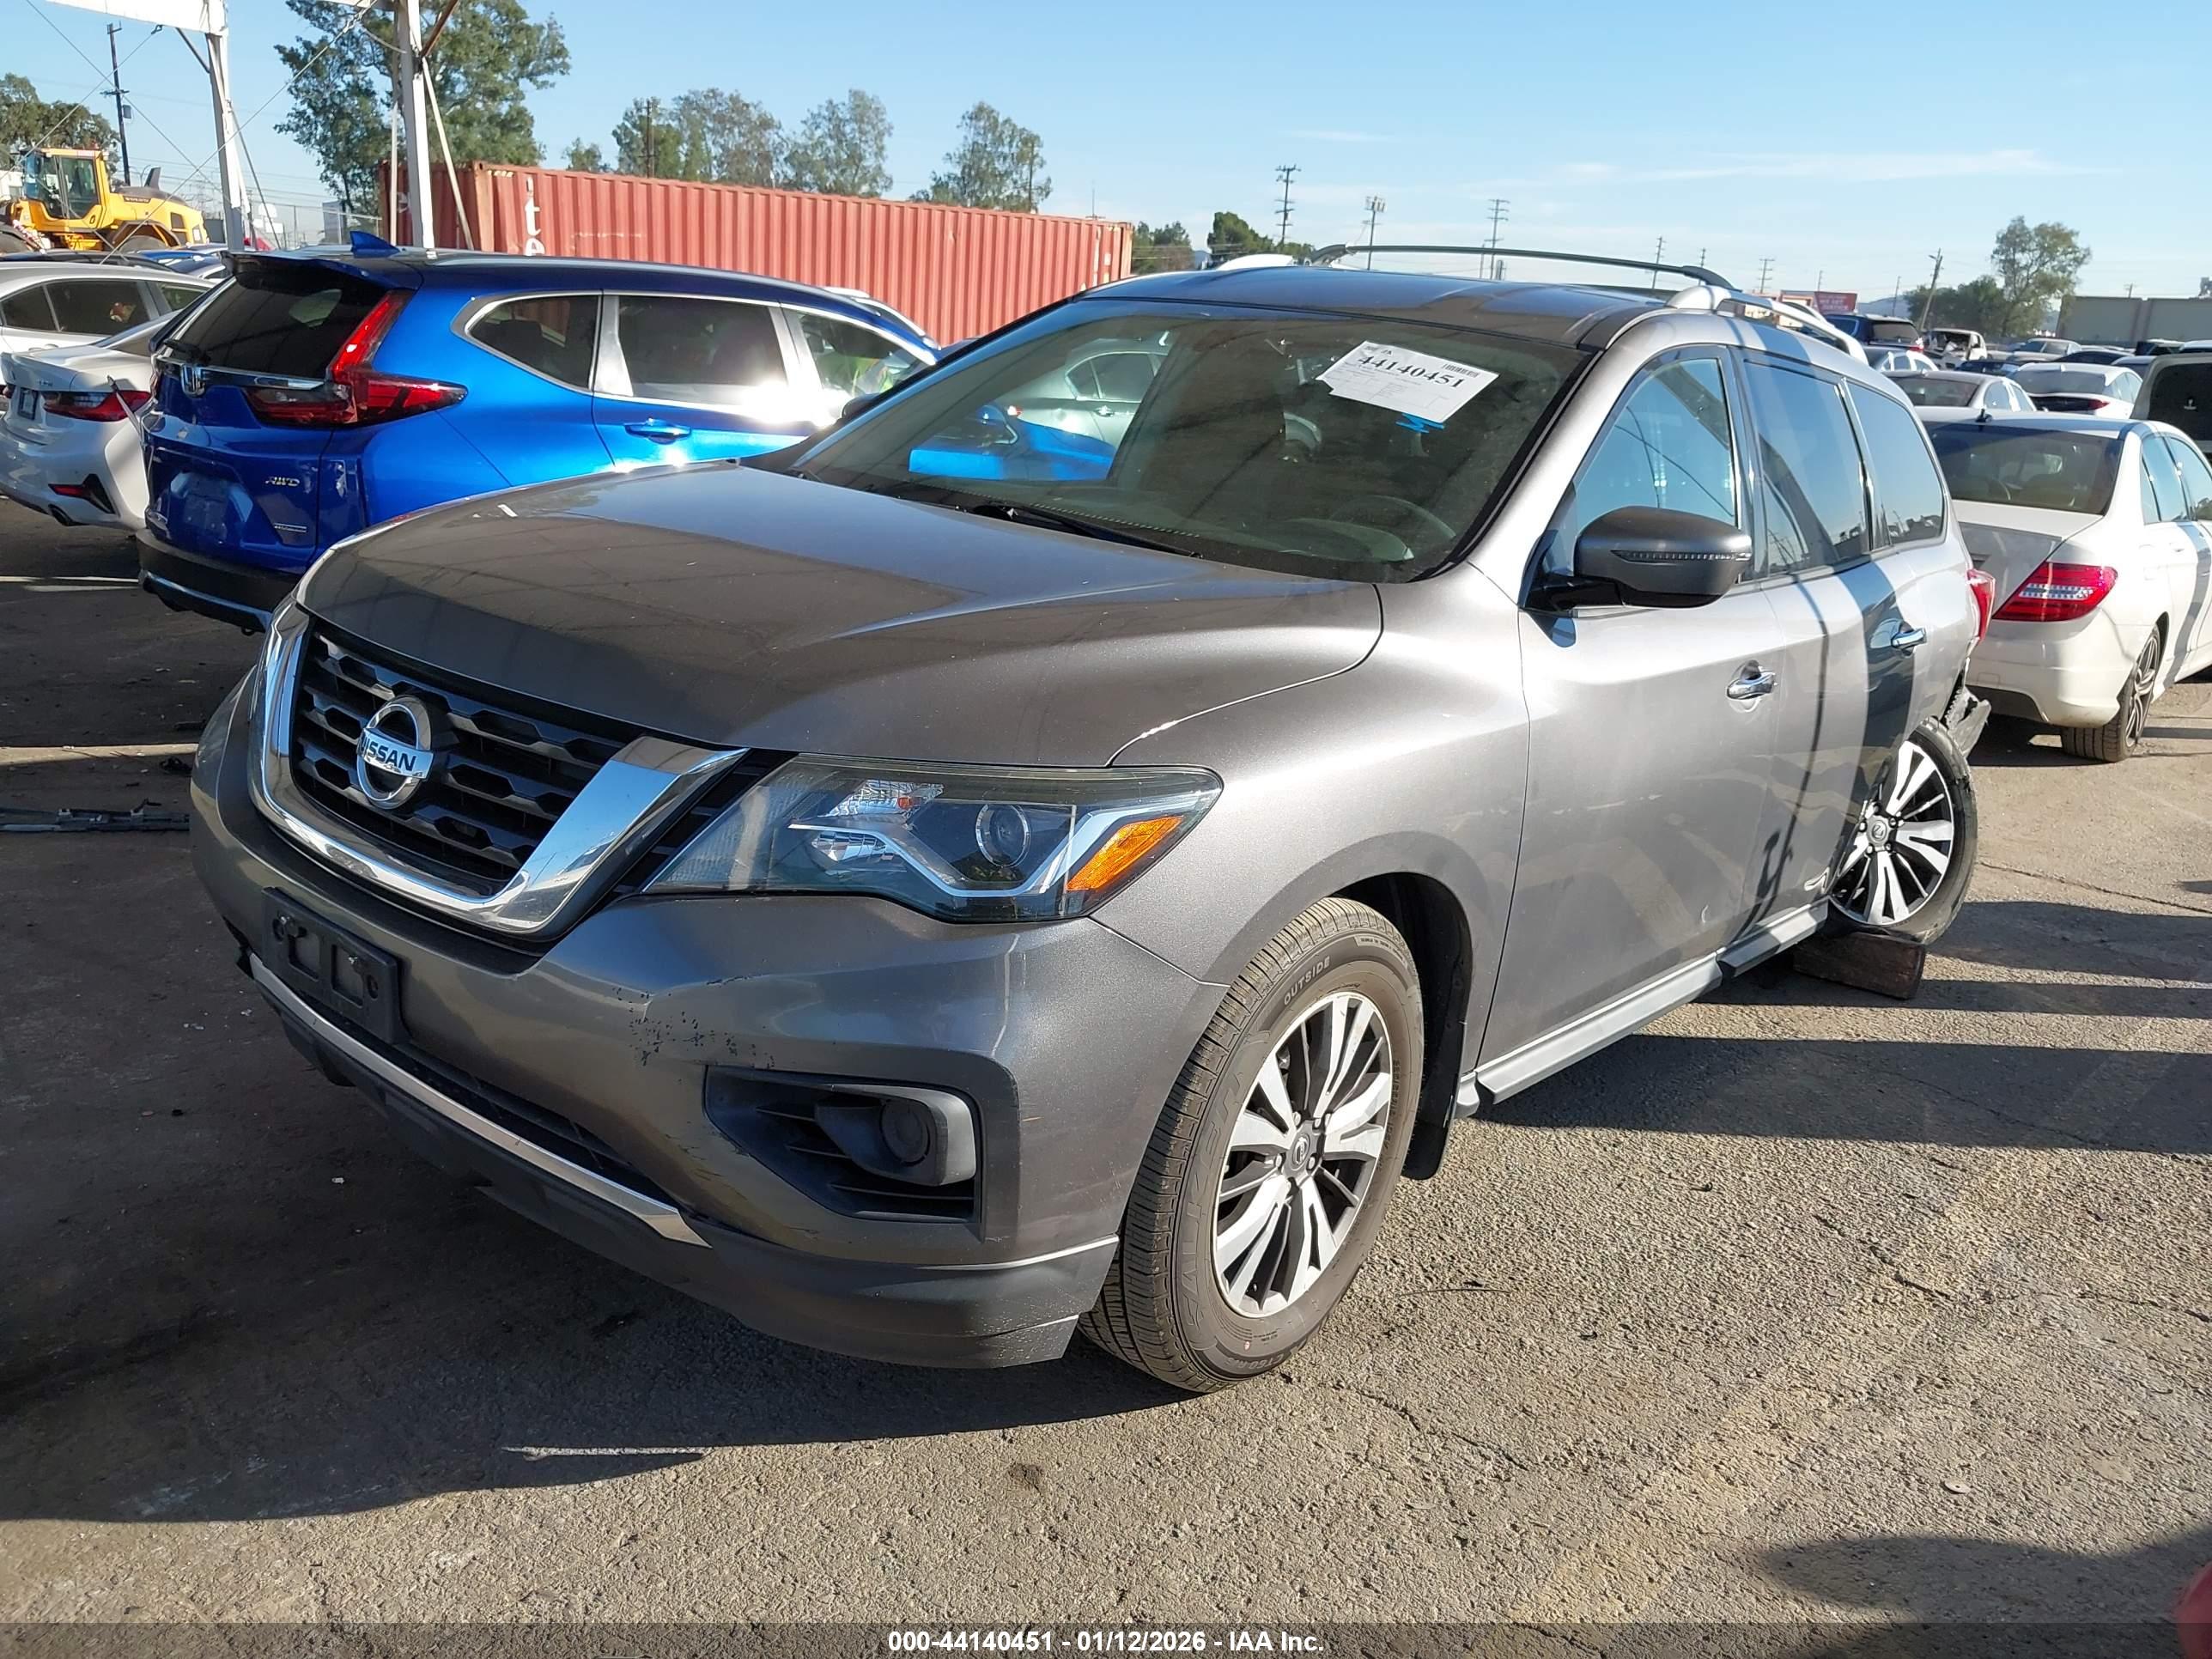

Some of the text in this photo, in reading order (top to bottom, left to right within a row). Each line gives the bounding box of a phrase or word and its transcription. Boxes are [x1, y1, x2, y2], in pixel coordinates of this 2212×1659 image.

[1358, 356, 1465, 388] 44140451
[265, 477, 301, 487] AWD
[360, 731, 417, 771] NISSAN
[1284, 955, 1331, 1006] OUTSIDE
